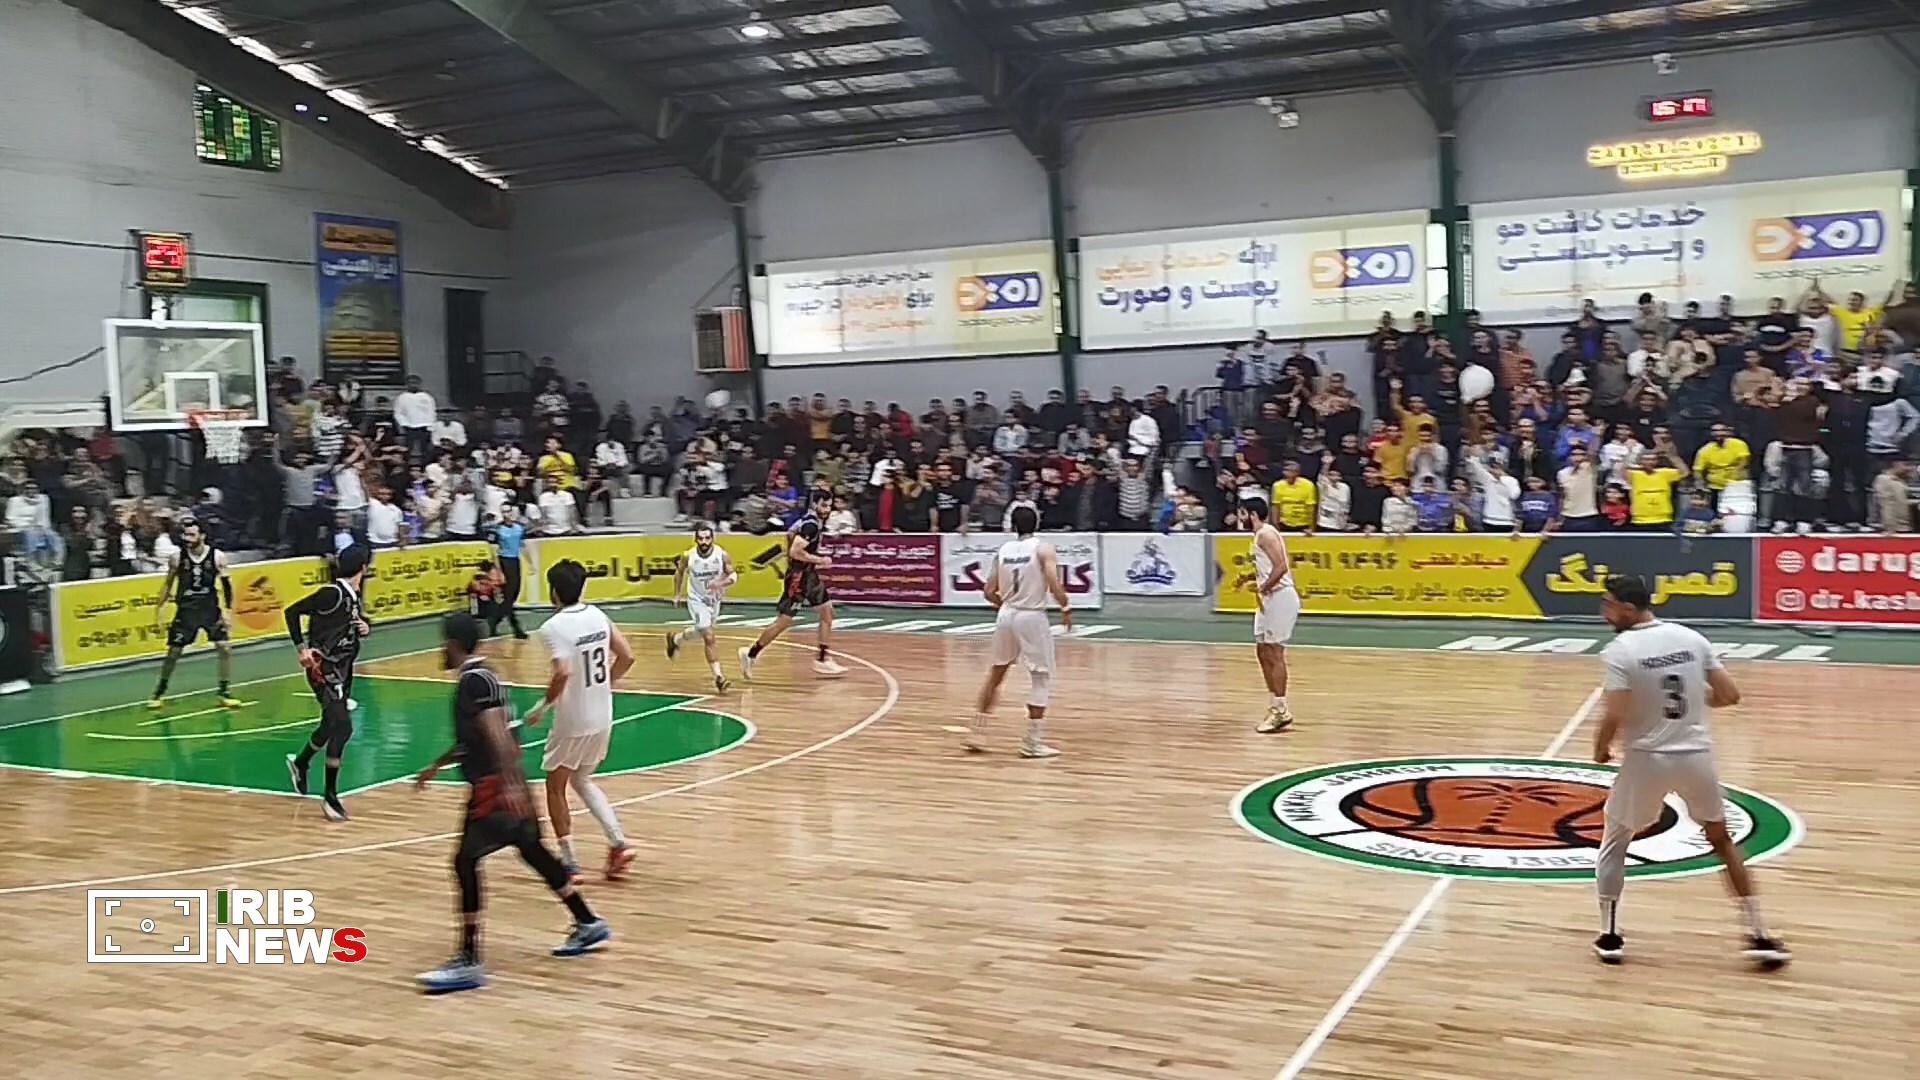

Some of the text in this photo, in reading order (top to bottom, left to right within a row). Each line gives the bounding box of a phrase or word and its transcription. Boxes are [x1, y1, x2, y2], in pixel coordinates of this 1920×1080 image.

[1497, 201, 1705, 245] خدمات کاشت مو
[1098, 286, 1171, 313] صورت
[1180, 286, 1193, 309] و
[1201, 281, 1279, 308] پوست
[1650, 562, 1738, 605] قصر
[1437, 636, 1834, 662] NAHL
[581, 647, 607, 688] 13
[1662, 674, 1687, 719] 3
[1366, 842, 1484, 866] SINCE
